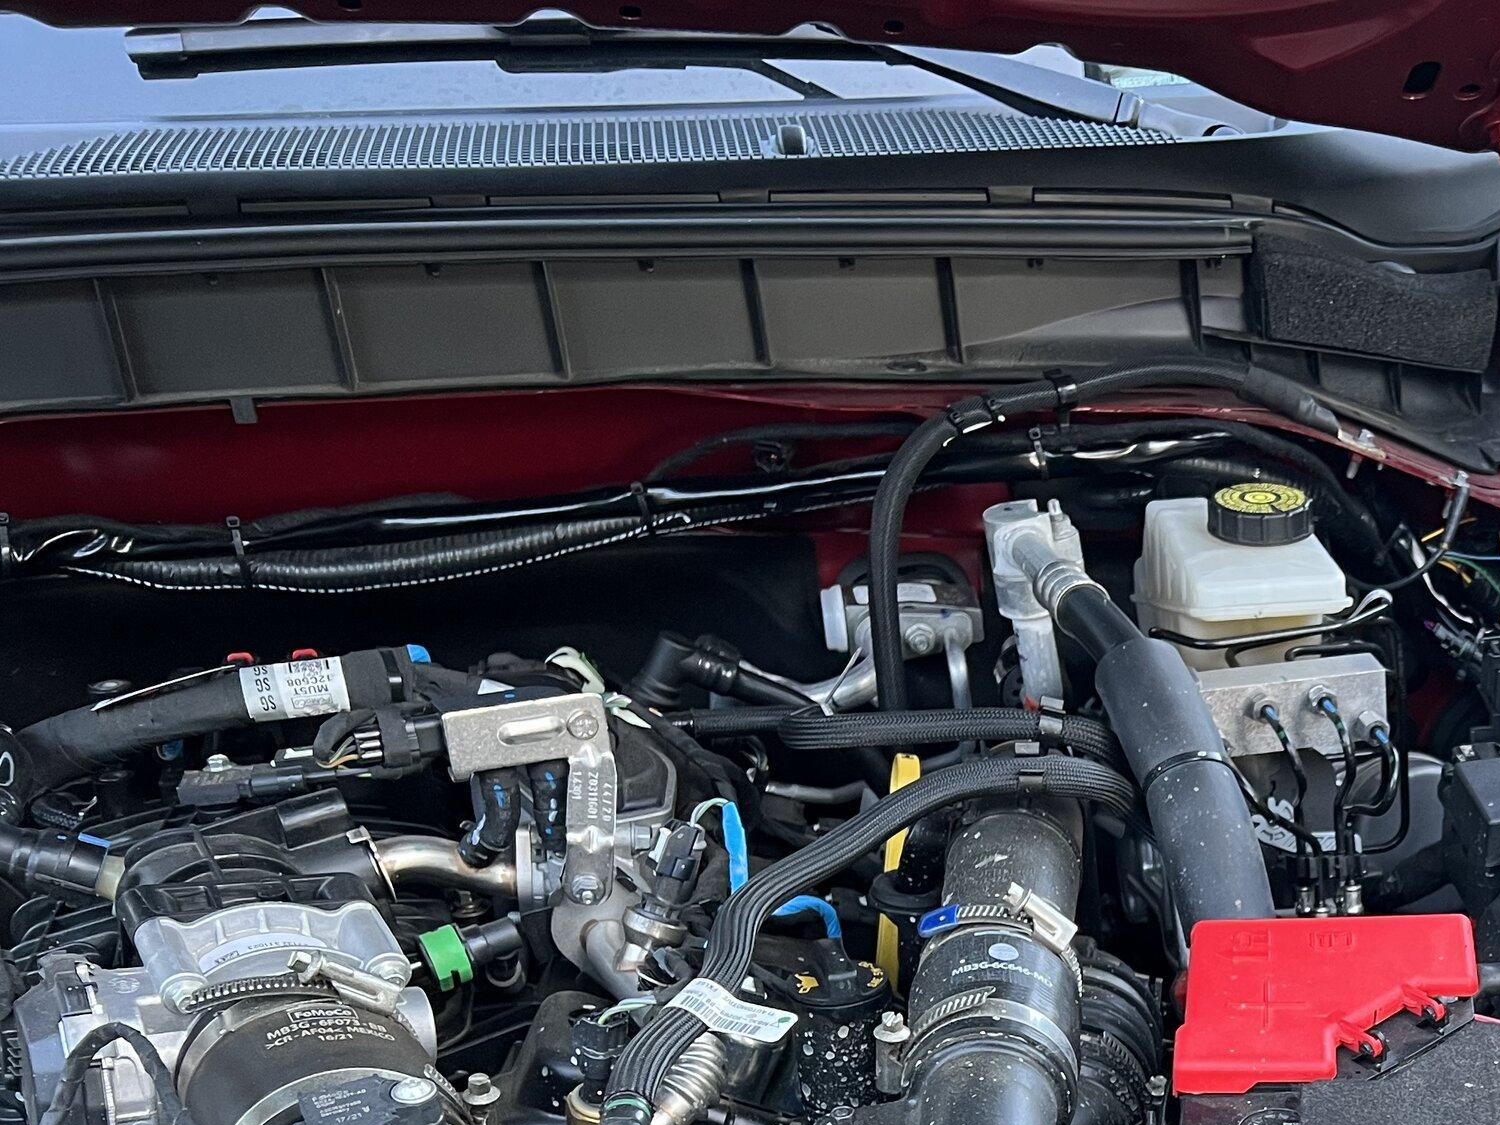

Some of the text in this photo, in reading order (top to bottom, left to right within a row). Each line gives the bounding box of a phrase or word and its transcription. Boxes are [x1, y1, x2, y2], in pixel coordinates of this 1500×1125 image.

[255, 677, 271, 692] SG
[260, 694, 277, 711] SG
[294, 1008, 352, 1019] FoMoCo
[346, 1026, 395, 1041] MEXICO
